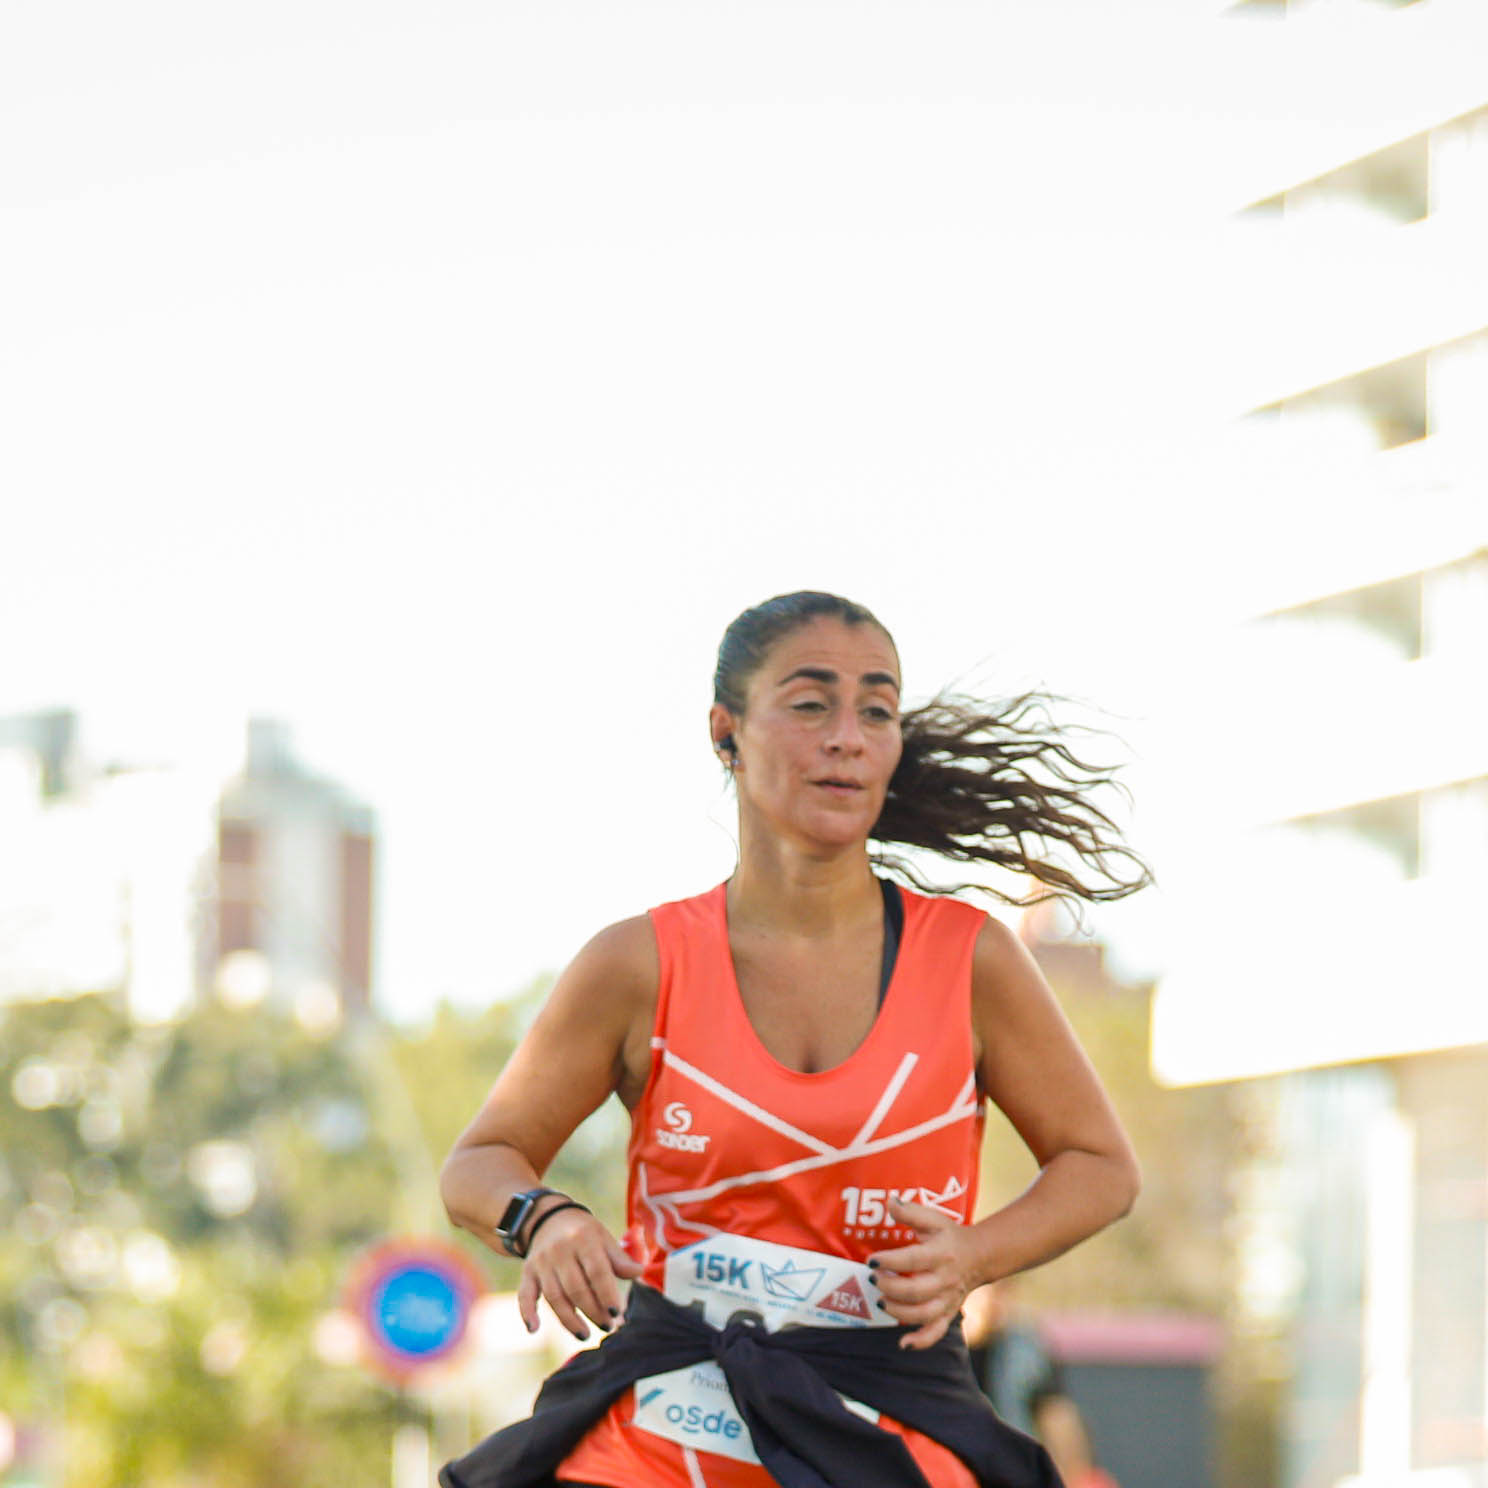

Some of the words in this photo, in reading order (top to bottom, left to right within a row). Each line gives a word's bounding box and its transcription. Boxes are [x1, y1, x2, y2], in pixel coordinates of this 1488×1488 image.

[693, 1251, 752, 1289] 15K
[832, 1289, 863, 1312] 15K
[665, 1404, 742, 1439] osde
